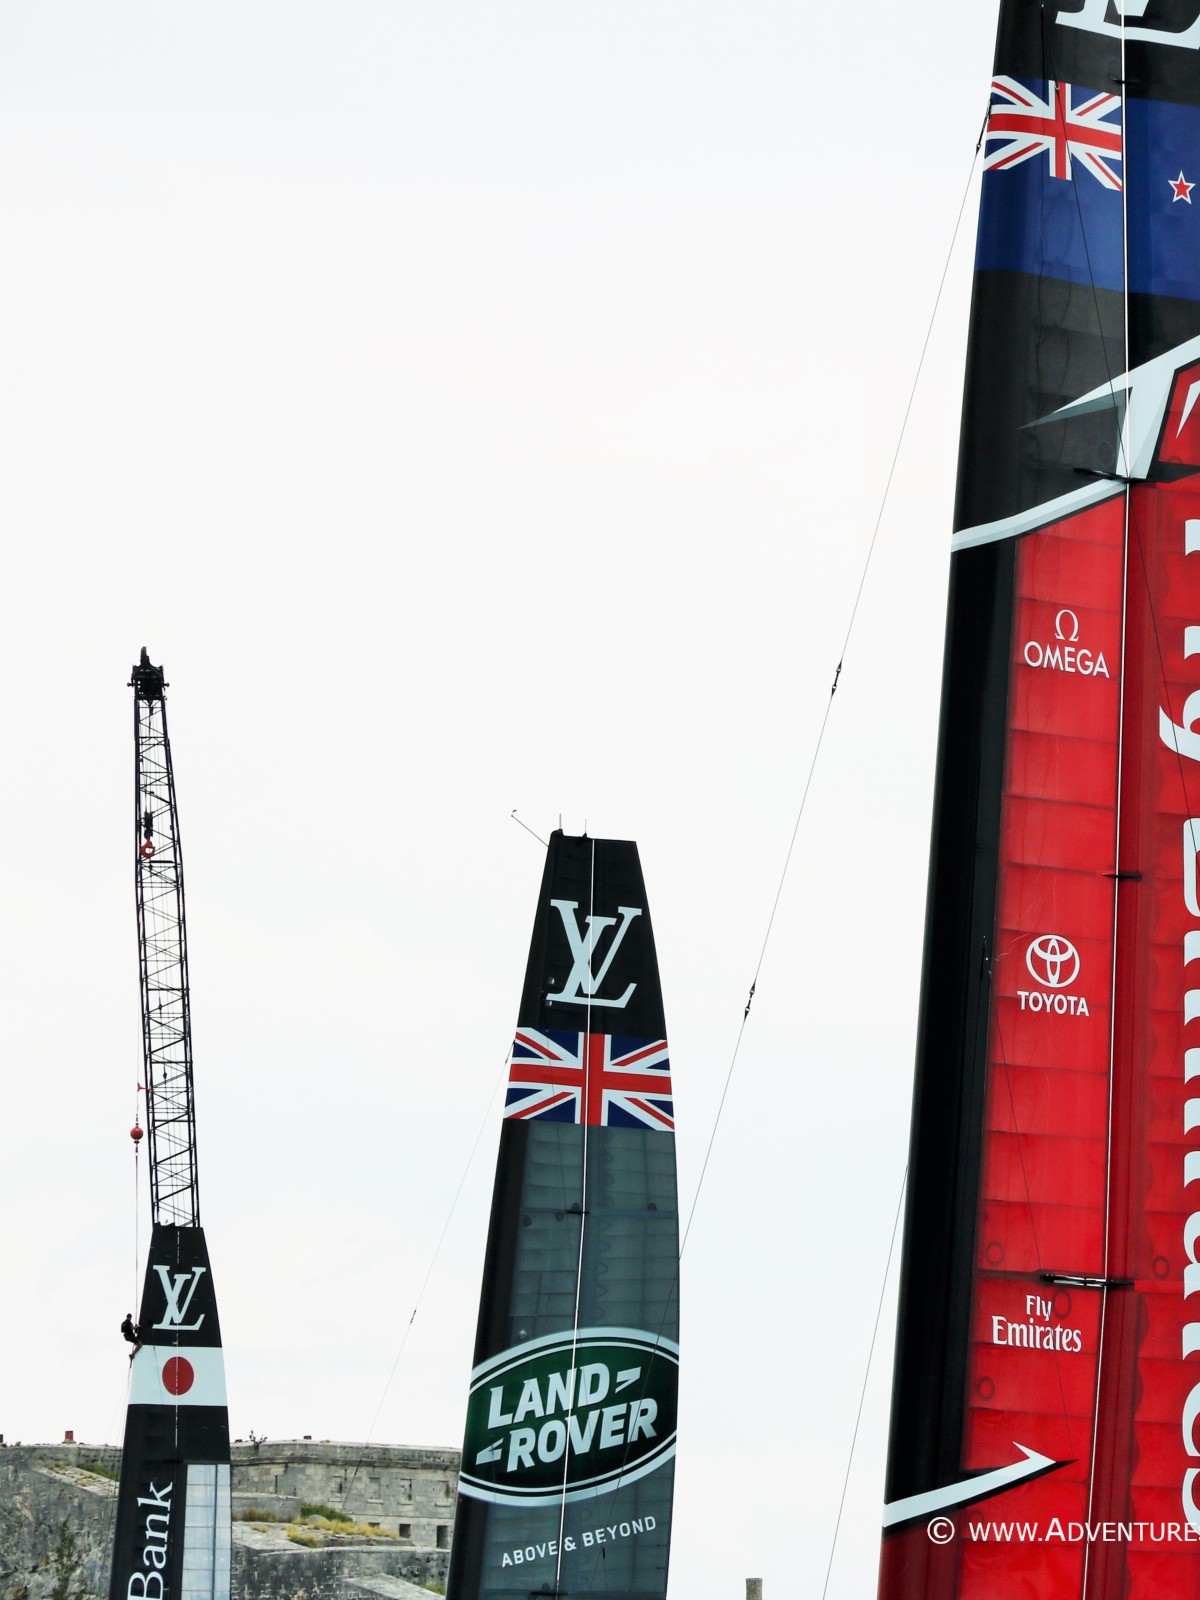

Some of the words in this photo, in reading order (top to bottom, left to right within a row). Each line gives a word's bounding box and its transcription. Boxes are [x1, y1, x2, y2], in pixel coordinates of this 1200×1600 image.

[1024, 641, 1110, 679] OMEGA
[1016, 990, 1090, 1017] TOYOTA
[1026, 1294, 1052, 1321] Fly
[992, 1315, 1082, 1352] Emirates
[488, 1362, 611, 1429] LAND
[506, 1398, 658, 1473] ROVER
[127, 1482, 174, 1600] Bank
[501, 1540, 558, 1568] ABOVE
[564, 1536, 577, 1551] &
[582, 1516, 657, 1547] BEYOND
